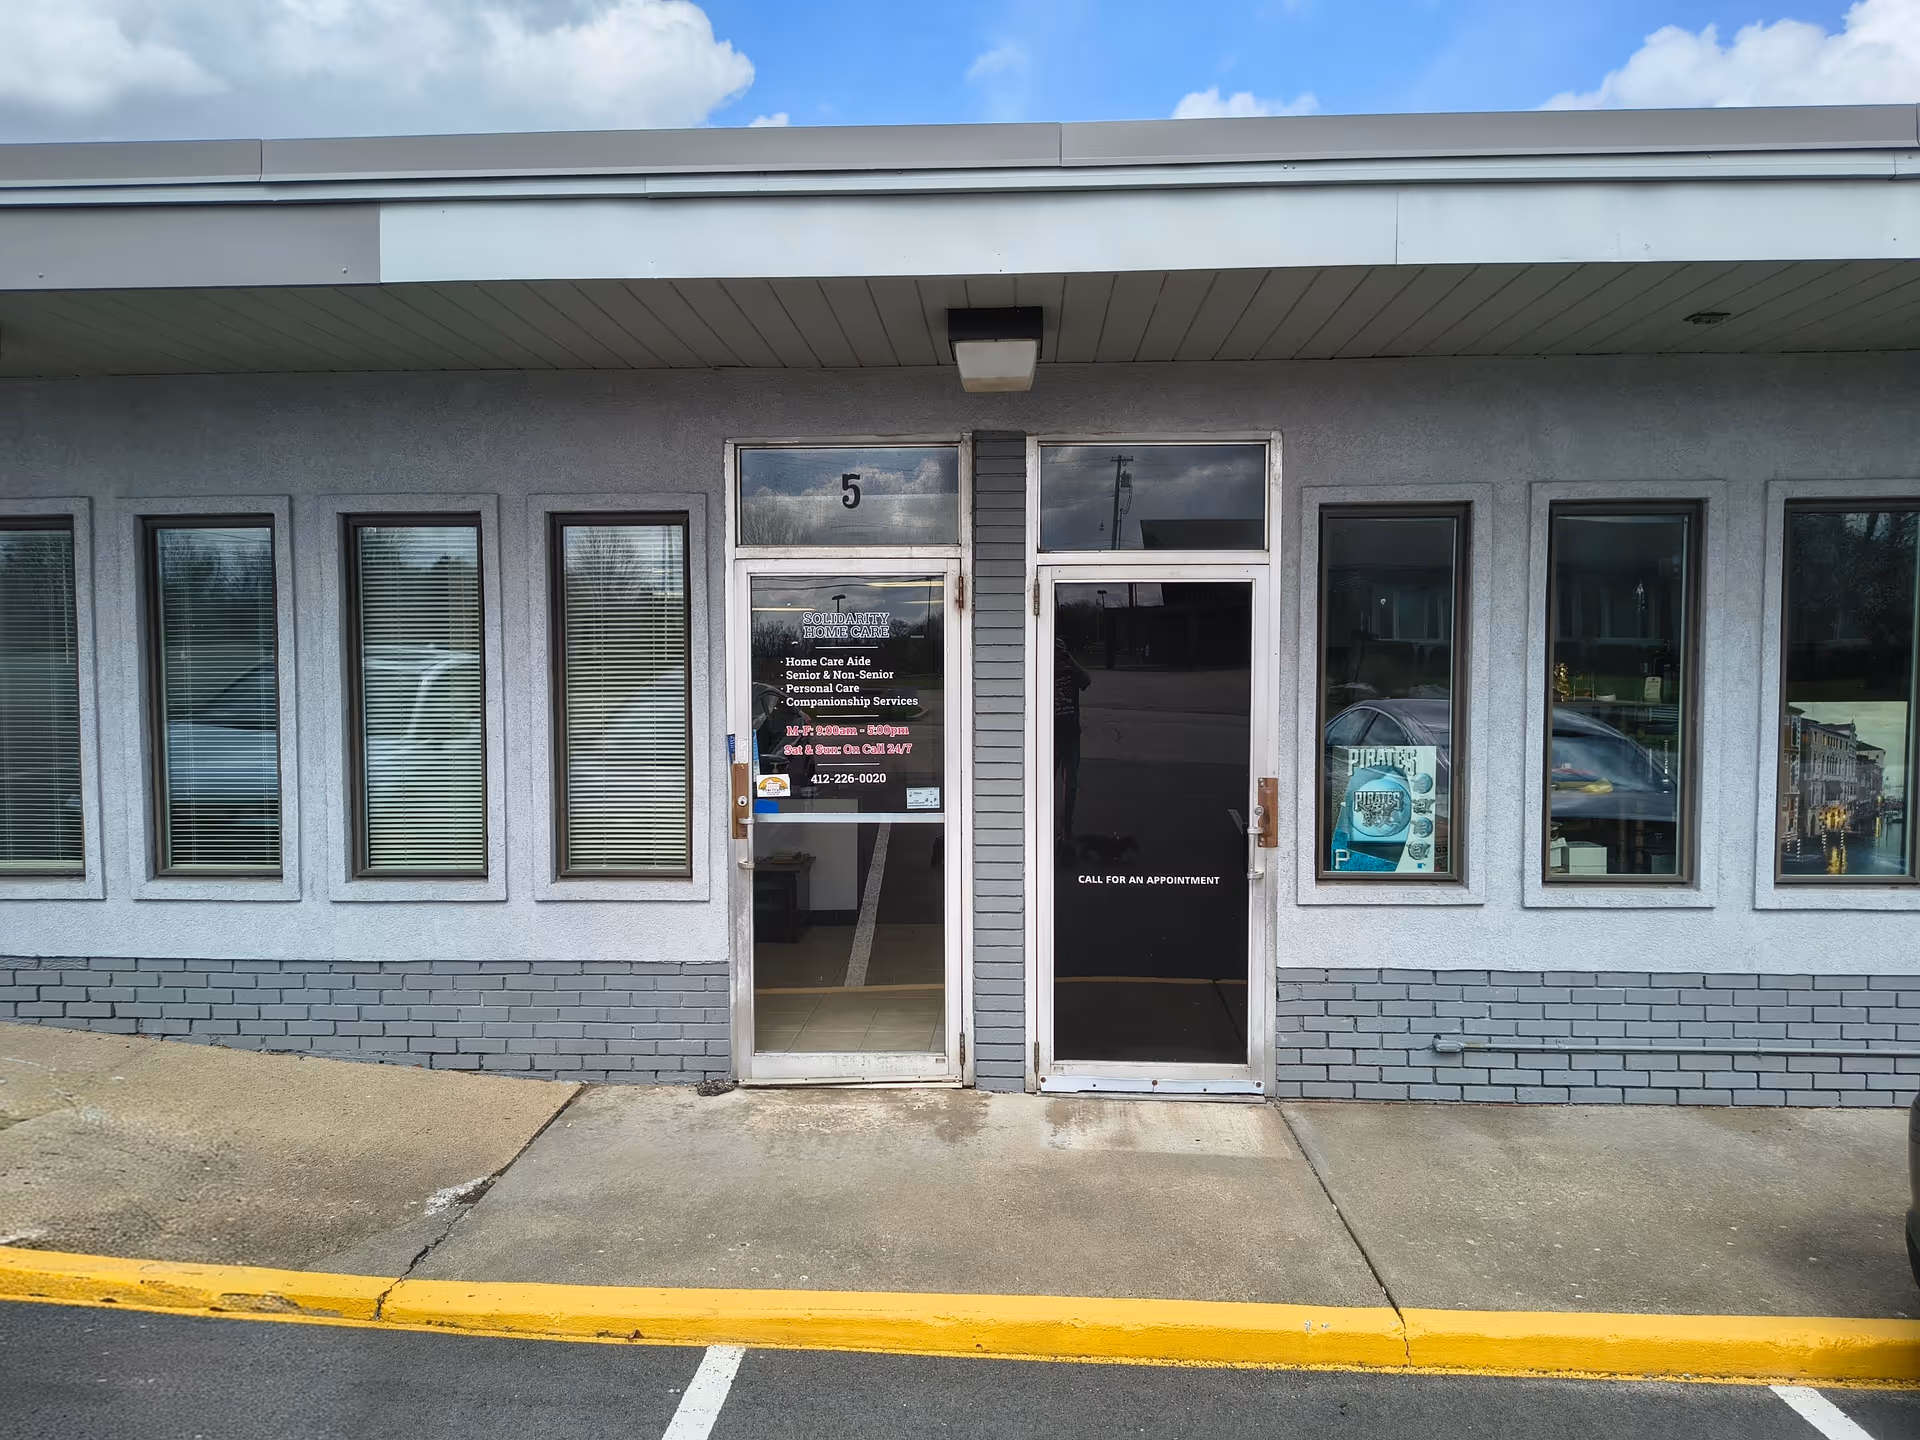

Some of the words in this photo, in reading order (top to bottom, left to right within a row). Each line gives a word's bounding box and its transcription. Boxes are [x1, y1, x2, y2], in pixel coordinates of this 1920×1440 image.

[842, 474, 861, 509] 5
[803, 612, 890, 626] SOLIDARITY
[804, 626, 848, 639] HOME
[850, 626, 890, 639] CARE
[785, 657, 817, 666] Home
[819, 657, 844, 666] Care
[846, 656, 871, 666] Aide
[786, 670, 821, 680] Senior
[823, 670, 831, 680] &
[833, 669, 894, 680] Non-Senior
[786, 683, 833, 693] Personal
[835, 684, 860, 693] Care
[786, 696, 871, 708] Companionship
[873, 696, 919, 706] Services
[786, 726, 814, 736] M-F:
[815, 725, 857, 736] 9:00am
[867, 724, 910, 737] 5:00pm
[784, 744, 803, 756] Sat
[804, 744, 814, 755] &
[815, 744, 842, 755] Sun:
[843, 744, 861, 755] On
[862, 743, 886, 755] Call
[887, 743, 913, 755] 24/7
[1348, 747, 1417, 777] PIRATES
[811, 773, 887, 784] 412-226-0020
[1353, 791, 1403, 812] PIRATES
[1334, 848, 1350, 869] P
[1078, 875, 1103, 884] CALL
[1106, 875, 1126, 884] FOR
[1128, 876, 1144, 884] AN
[1146, 876, 1220, 885] APPOINTMENT
